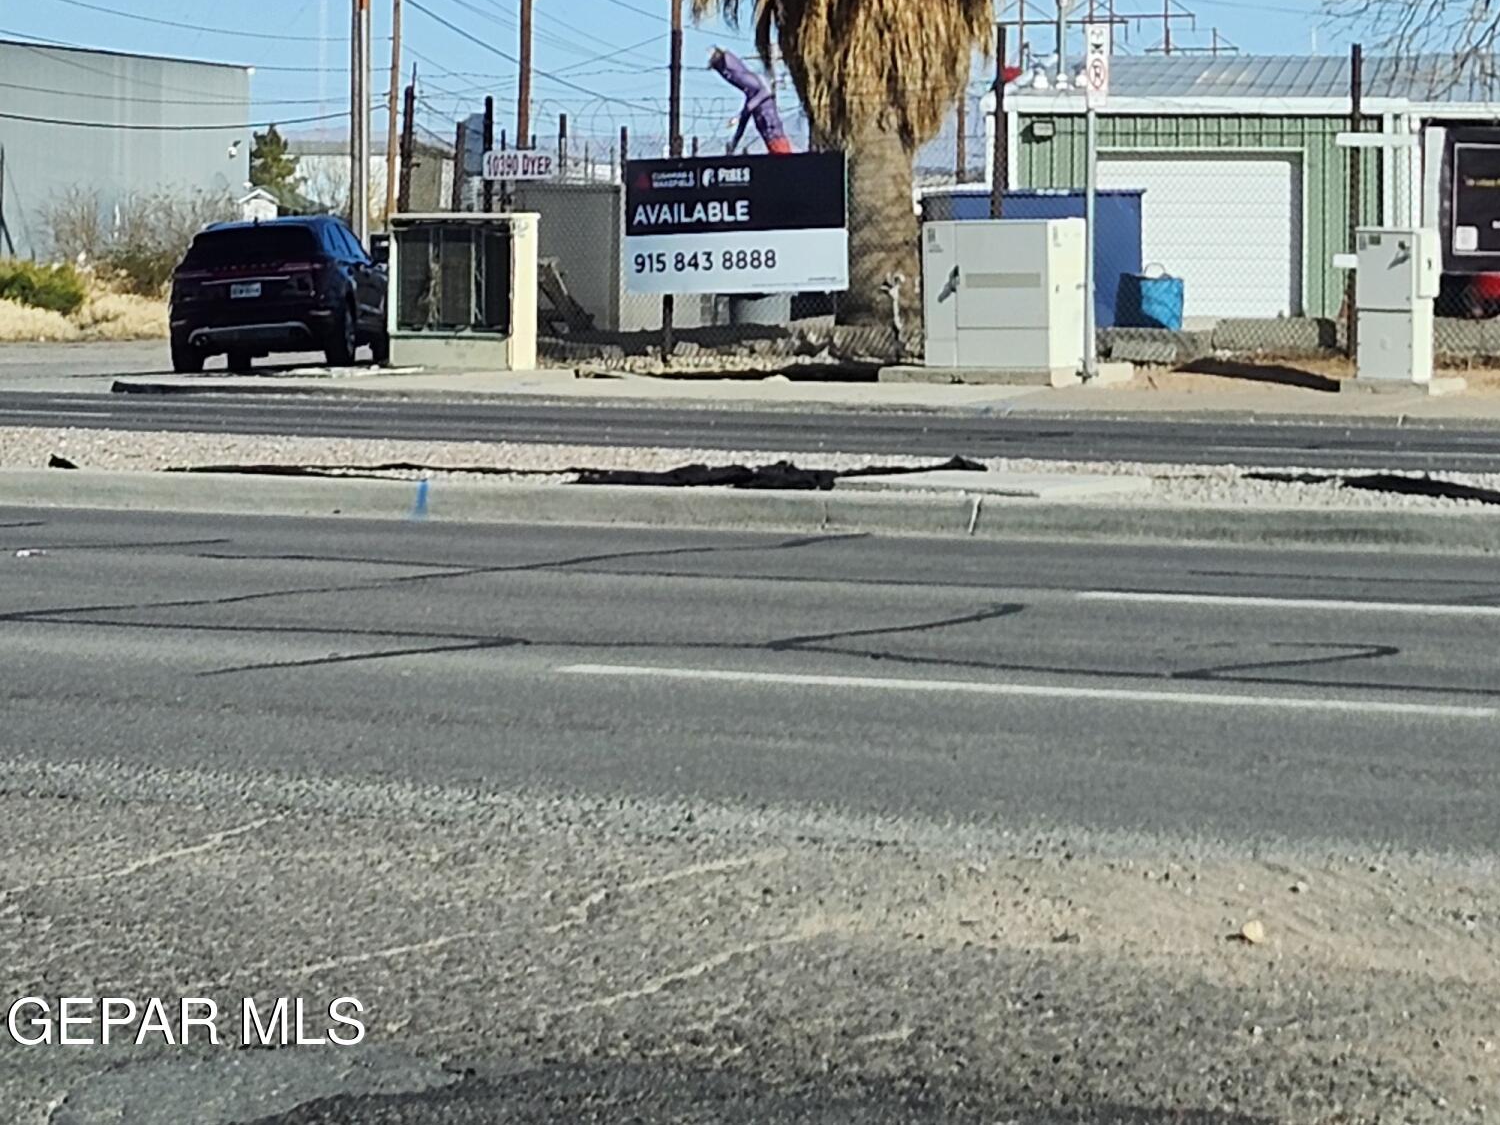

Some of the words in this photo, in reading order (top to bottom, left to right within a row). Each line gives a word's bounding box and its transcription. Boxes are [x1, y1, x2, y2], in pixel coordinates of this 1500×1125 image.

[522, 154, 552, 175] DYER
[632, 200, 751, 225] AVAILABLE
[634, 252, 667, 273] 915
[674, 251, 714, 271] 843
[722, 249, 777, 271] 8888
